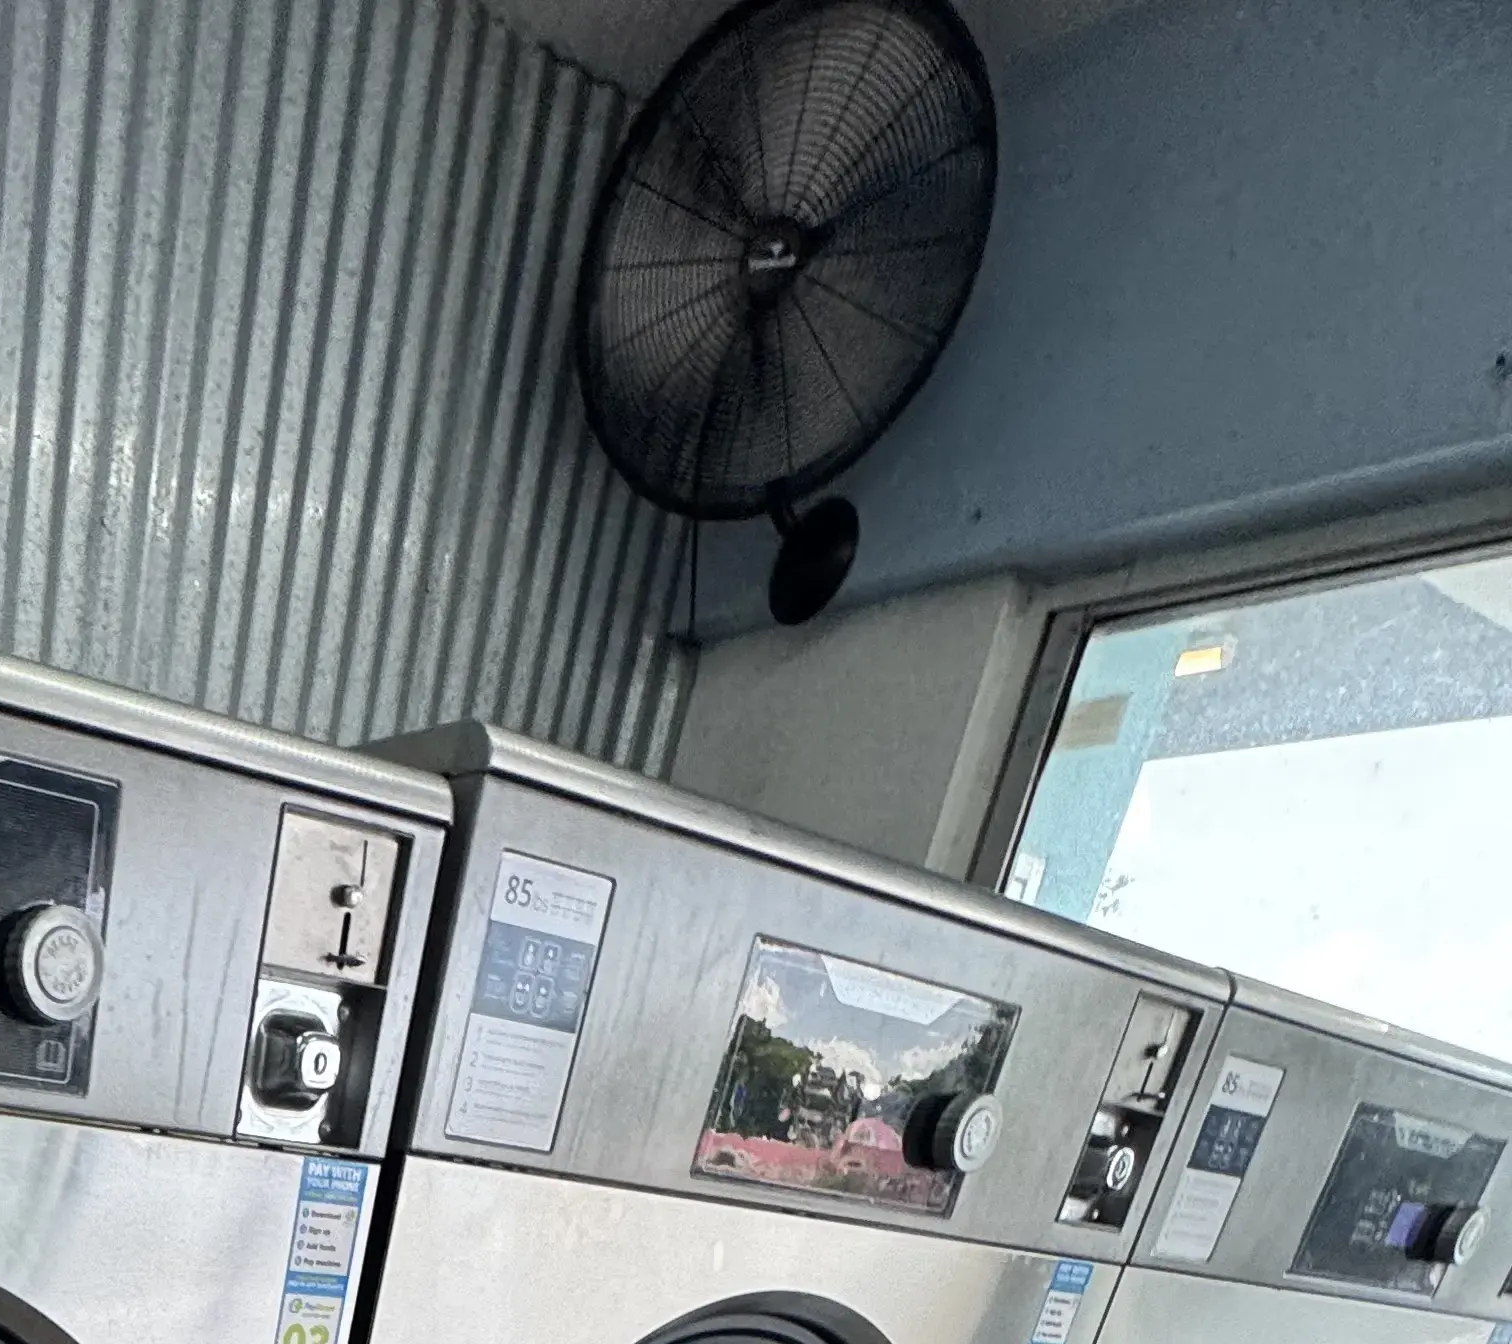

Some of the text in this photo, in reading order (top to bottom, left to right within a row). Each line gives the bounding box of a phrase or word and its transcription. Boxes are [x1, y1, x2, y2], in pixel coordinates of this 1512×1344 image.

[504, 875, 534, 907] 85
[307, 1163, 362, 1183] PAY WITH
